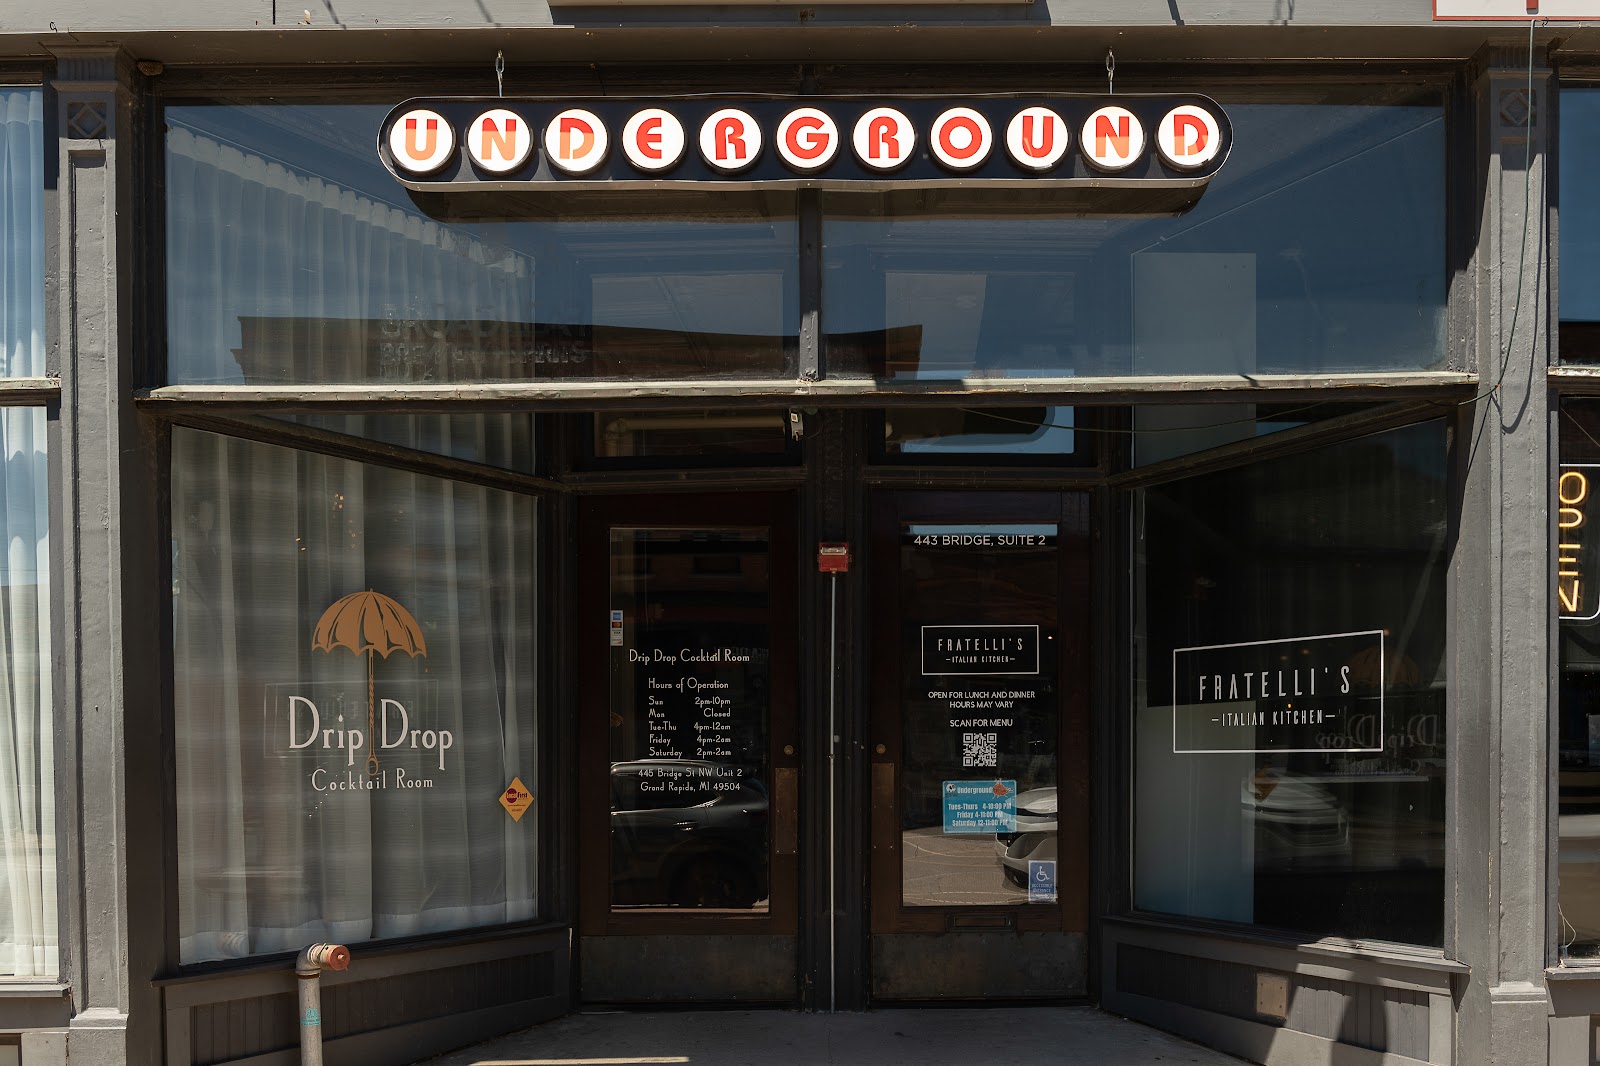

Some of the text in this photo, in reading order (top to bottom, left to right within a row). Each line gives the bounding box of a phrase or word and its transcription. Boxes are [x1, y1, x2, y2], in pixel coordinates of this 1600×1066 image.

[405, 113, 1209, 161] UNDERGROUND
[914, 535, 1046, 547] 443 BRIDGE, SUITE 2
[938, 638, 1023, 651] FRATELLI'S
[629, 649, 650, 665] Drip
[654, 649, 677, 665] Drop
[680, 649, 720, 662] Cocktail
[725, 649, 750, 662] Room
[648, 677, 729, 693] Hours of Operation
[1200, 666, 1350, 700] FRATELLI'S
[928, 691, 948, 699] OPEN
[949, 691, 963, 699] FOR
[964, 691, 989, 699] LUNCH
[991, 691, 1007, 699] AND
[648, 696, 731, 708] Sun 2pm-10pm
[648, 708, 731, 718] Mon Closed
[1222, 709, 1323, 727] ITALIAN KITCHEN
[649, 721, 731, 733] Tue-Thu 4pm-12am
[950, 719, 1013, 727] SCAN FOR MENU
[288, 696, 453, 770] Drip Drop
[649, 734, 731, 747] Friday 4pm-2am
[649, 747, 731, 759] Saturday 2pm-2am
[311, 768, 434, 791] Cocktail Room
[638, 768, 743, 780] 445 Bridge St NW Unit 2
[640, 782, 741, 794] Grand Rapids, MI 49504
